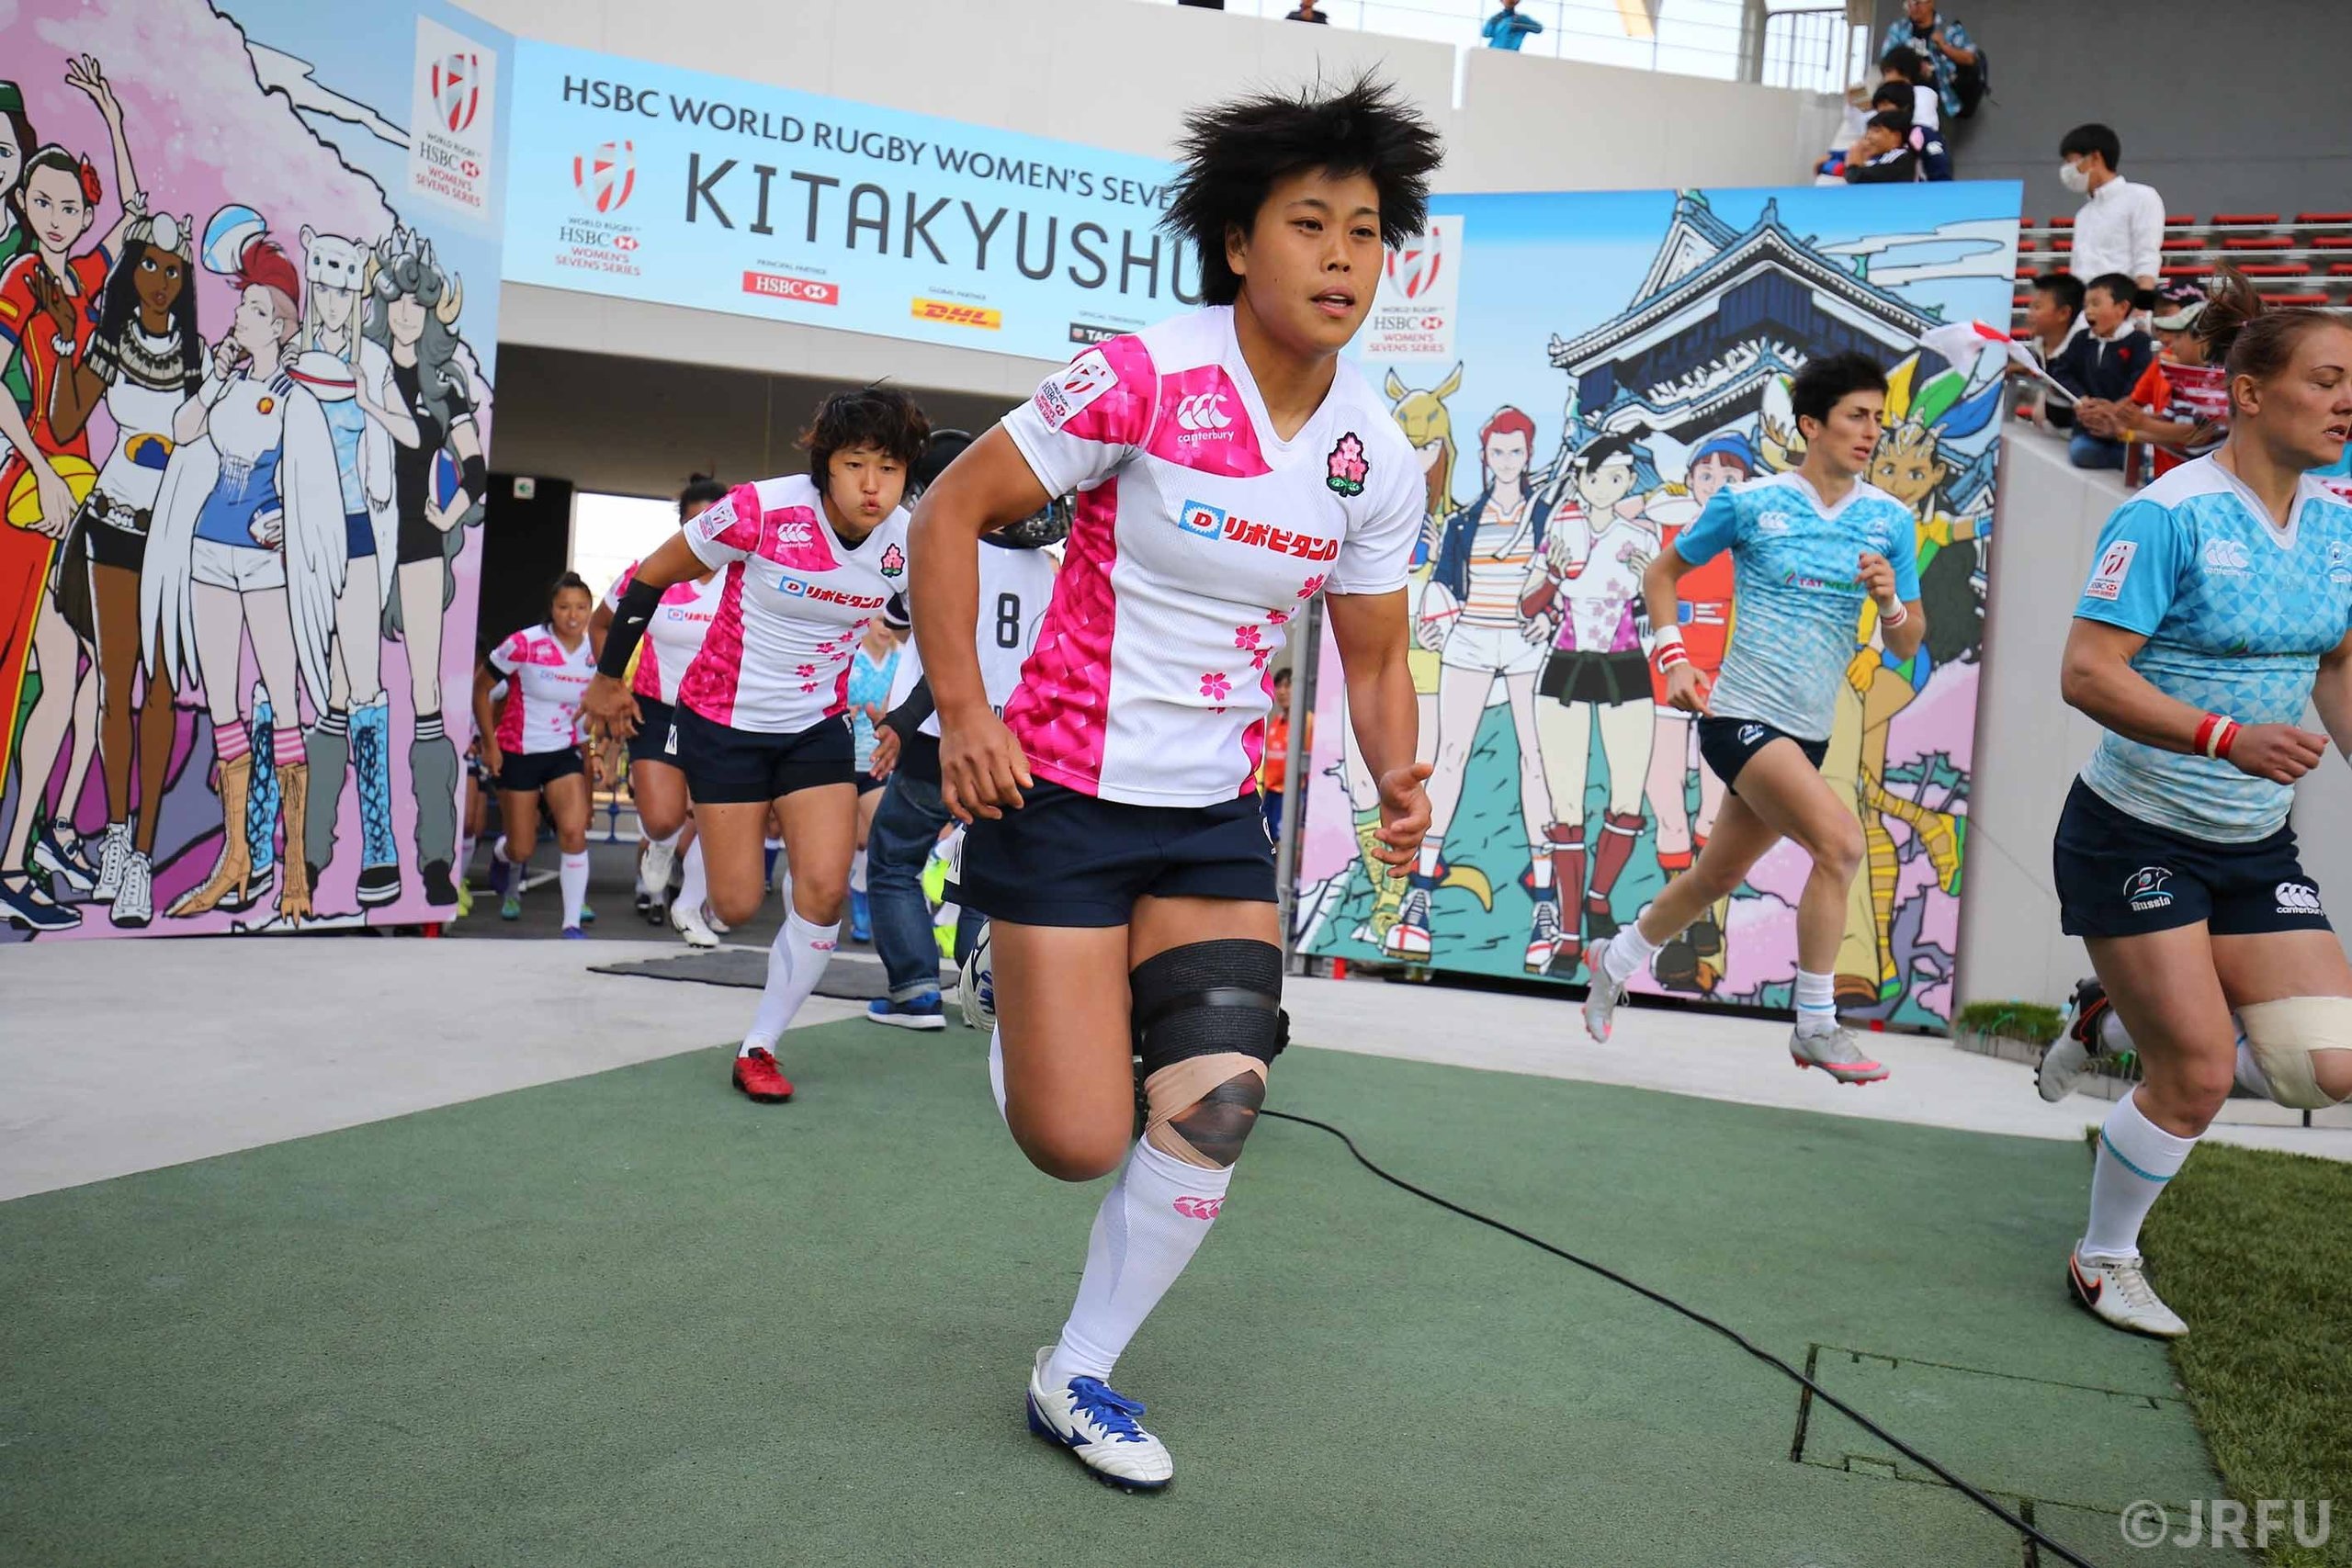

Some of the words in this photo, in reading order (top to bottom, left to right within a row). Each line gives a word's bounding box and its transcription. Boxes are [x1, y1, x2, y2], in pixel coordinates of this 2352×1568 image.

[562, 74, 660, 118] HSBC
[669, 95, 804, 142] WORLD
[813, 121, 927, 164] RUGBY
[933, 144, 1094, 197] WOMEN’S
[1102, 176, 1172, 211] SEVE
[419, 141, 459, 171] HSBC
[428, 166, 472, 191] WOMEN'S
[416, 173, 450, 195] SEVENS
[452, 187, 481, 207] SERIES
[569, 216, 602, 229] WORLD
[685, 152, 1201, 306] KITAKYUSHU
[560, 226, 611, 246] HSBC
[555, 254, 600, 270] SEVENS
[602, 262, 641, 276] SERIES
[571, 246, 629, 264] WOMEN'S
[756, 276, 803, 296] HSBC
[924, 303, 987, 325] DHL
[1374, 315, 1419, 331] HSBC
[1369, 343, 1408, 353] SEVENS
[1410, 343, 1446, 353] SERIES
[1383, 333, 1434, 343] WOMEN'S
[1042, 381, 1059, 405] HSBC
[1177, 430, 1235, 445] canterbury
[1223, 515, 1339, 562] リポビタンD
[806, 585, 885, 610] リポビタンD
[684, 611, 714, 622] リポビ
[996, 592, 1021, 649] 8
[2131, 896, 2172, 912] Russia
[2276, 906, 2324, 917] canterbury
